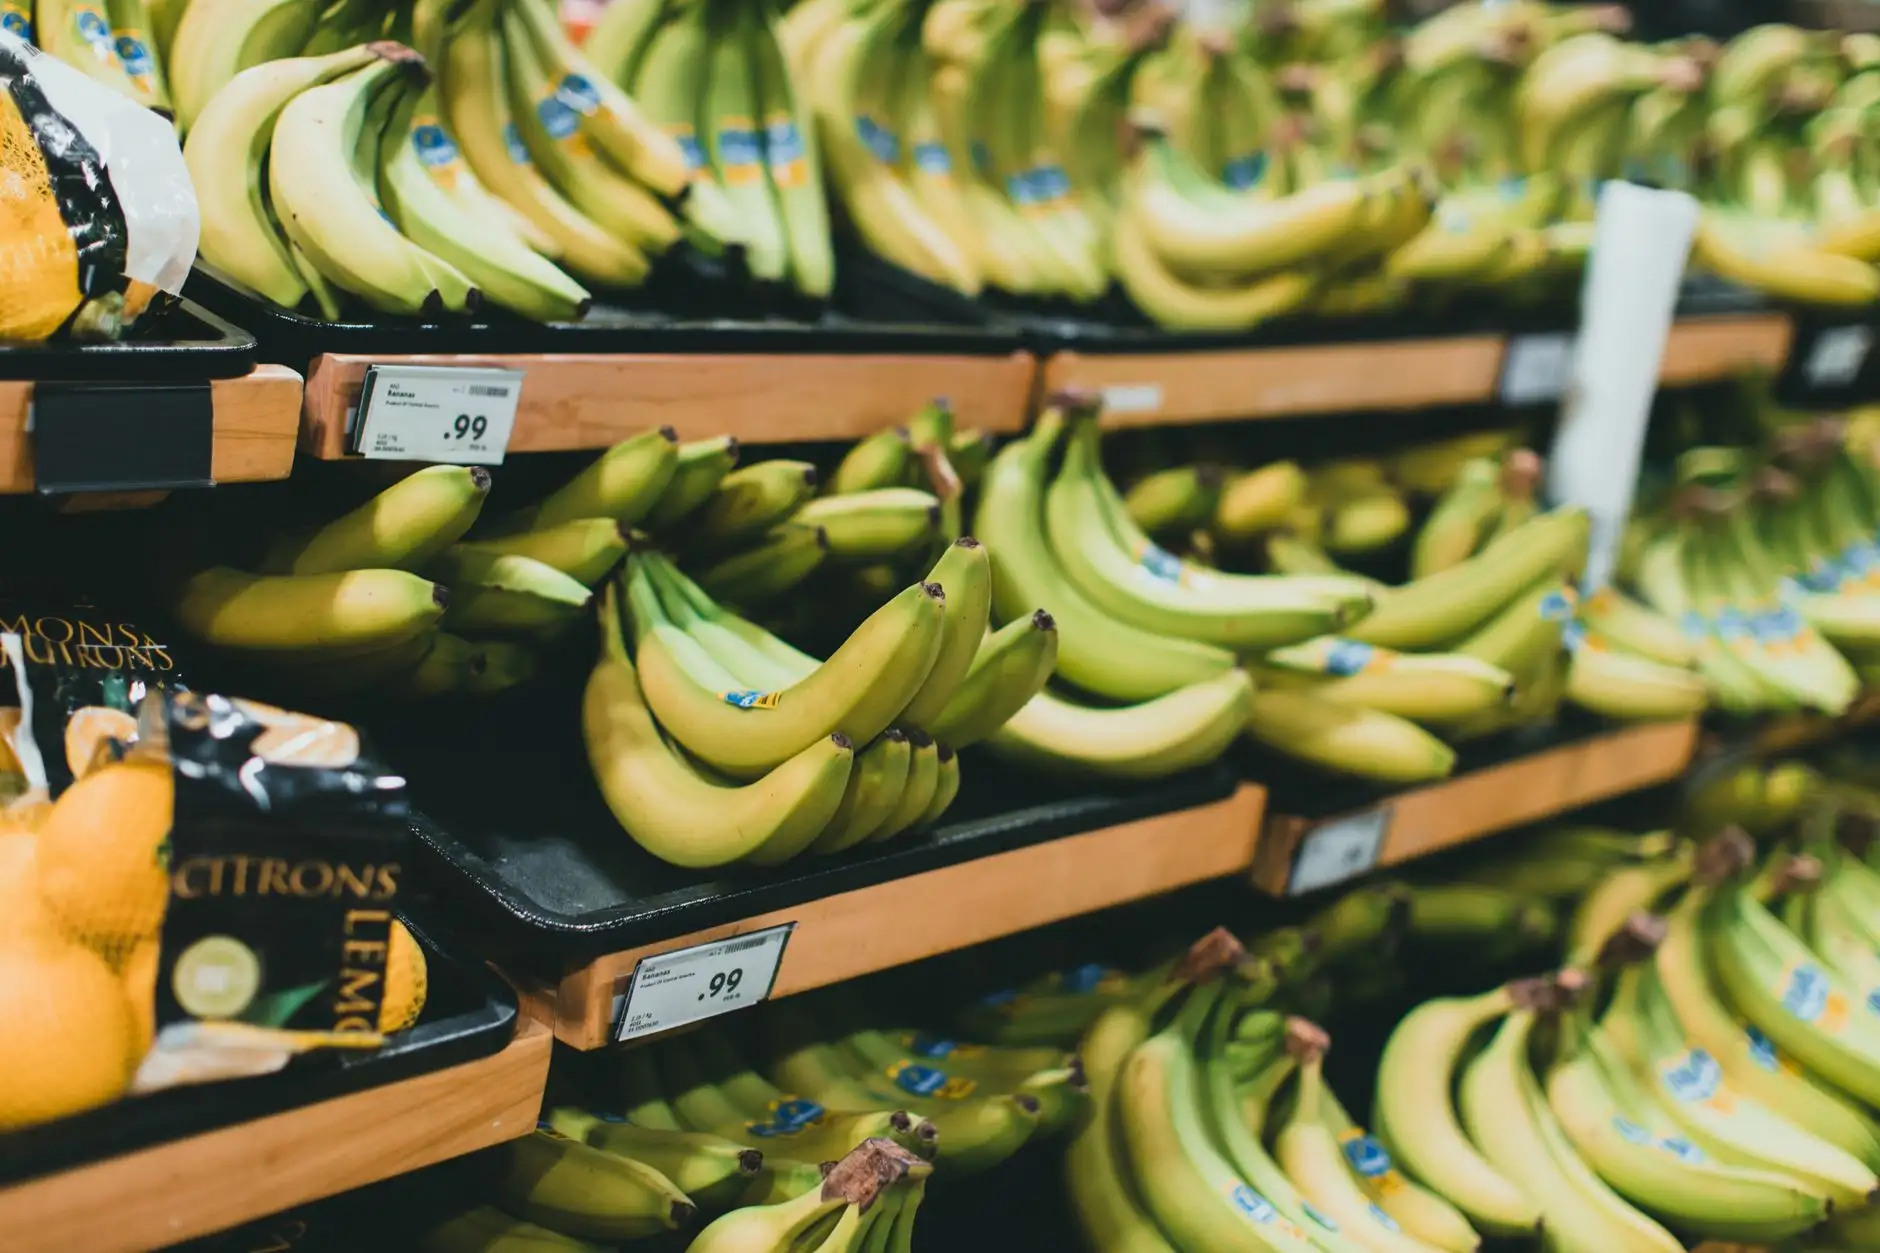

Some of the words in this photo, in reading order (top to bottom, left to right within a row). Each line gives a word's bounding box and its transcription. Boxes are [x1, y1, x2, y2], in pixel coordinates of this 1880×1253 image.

[443, 414, 488, 441] .99
[171, 853, 402, 900] CITRONS
[642, 969, 671, 980] Bananas
[697, 967, 743, 1001] .99
